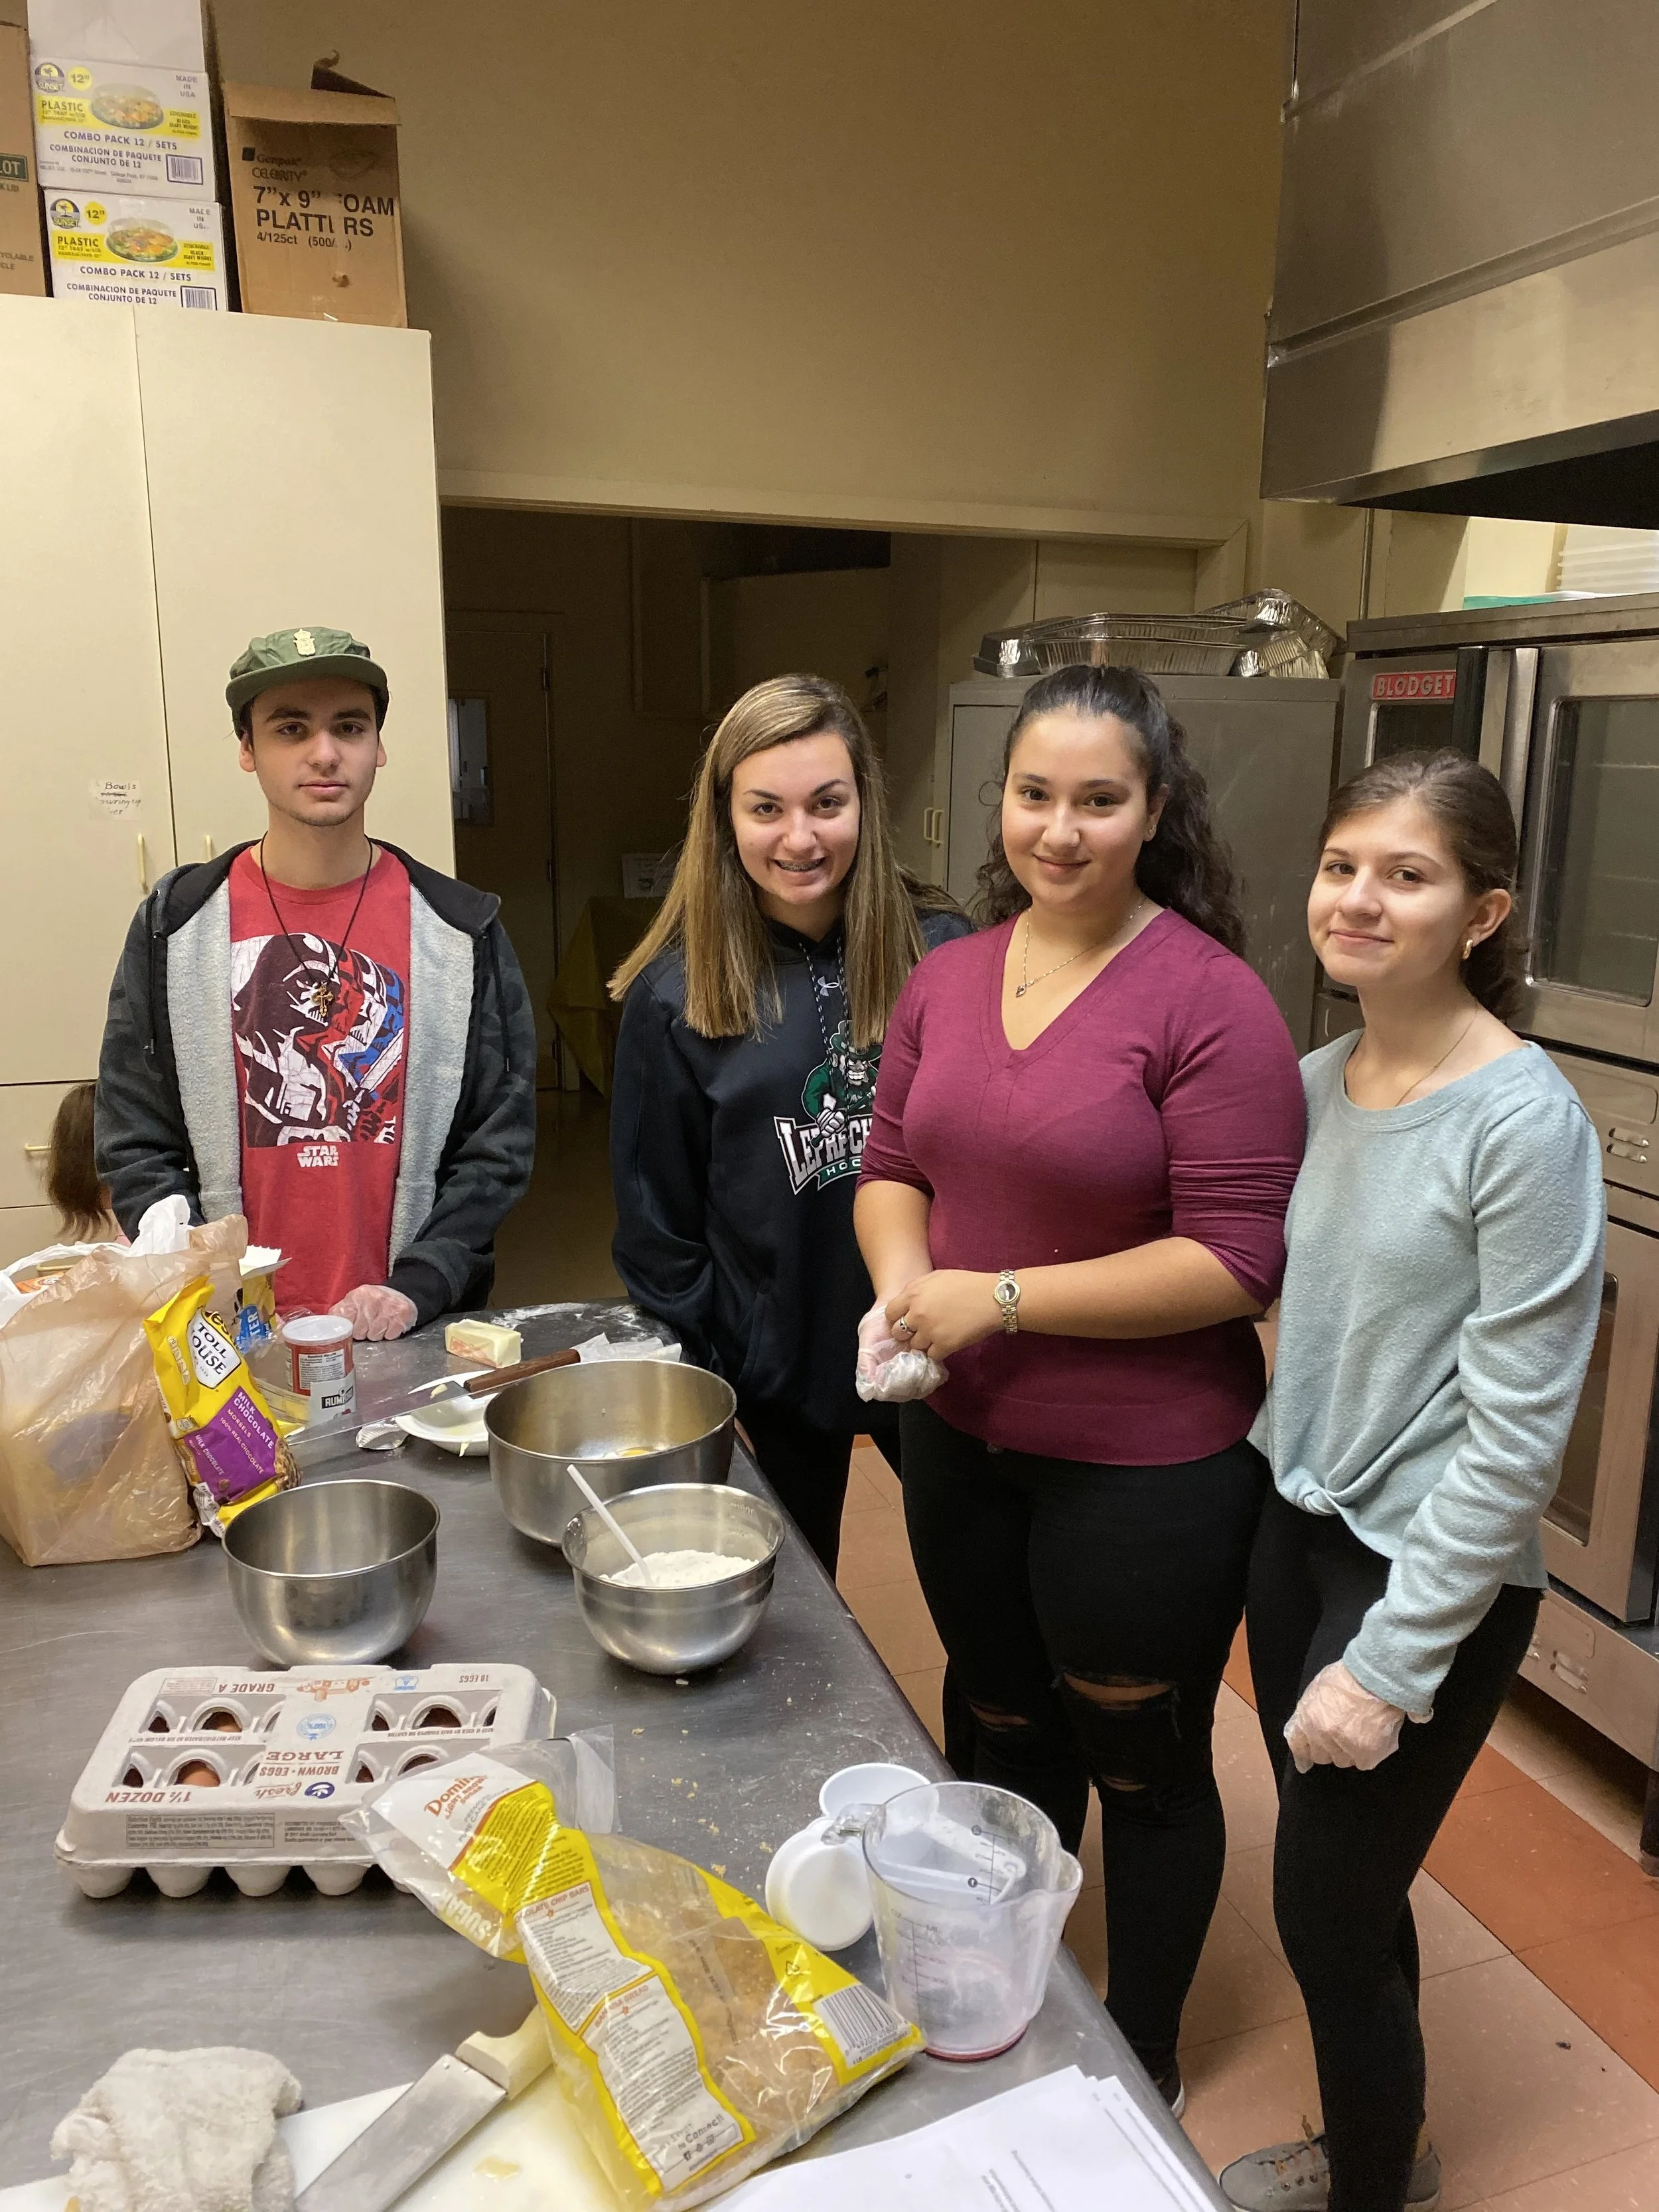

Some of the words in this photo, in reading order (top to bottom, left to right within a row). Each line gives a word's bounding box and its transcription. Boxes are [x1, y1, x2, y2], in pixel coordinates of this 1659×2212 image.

[41, 100, 83, 112] PLASTIC
[64, 131, 101, 141] COMBO
[105, 134, 130, 145] PACK
[155, 140, 177, 150] SETS
[50, 144, 109, 156] COMBINACION
[126, 151, 161, 161] PAQUETE
[72, 155, 117, 166] CONJUNTO
[337, 192, 394, 216] OAM
[53, 218, 79, 226] SUNSET
[58, 236, 98, 247] PLASTIC
[257, 232, 298, 244] 4/125ct
[80, 266, 116, 276] COMBO
[120, 268, 145, 278] PACK
[149, 271, 159, 279] 12
[170, 273, 191, 281] SETS
[67, 283, 126, 294] COMBINACION
[141, 288, 177, 297] PAQUETE
[88, 293, 133, 303] CONJUNTO
[297, 1145, 338, 1157] STAR
[297, 1155, 339, 1168] WARS
[199, 1323, 226, 1359] TOLL
[192, 1330, 226, 1374] OUSE
[238, 1392, 256, 1415] MILK
[227, 1409, 252, 1438] MORSELS
[234, 1398, 274, 1449] CHOCOLATE
[220, 1417, 232, 1432] 100%
[232, 1431, 242, 1445] REAL
[241, 1443, 263, 1475] CHOCOLATE
[195, 1434, 204, 1449] MILK
[204, 1447, 225, 1476] CHOCOLATE
[218, 1684, 227, 1692] A
[230, 1683, 275, 1692] GRADE
[267, 1751, 344, 1761] LARGE
[259, 1767, 287, 1777] EGGS
[297, 1766, 340, 1775] BROWN
[255, 1782, 302, 1799] fresh
[105, 1792, 165, 1803] DOZEN
